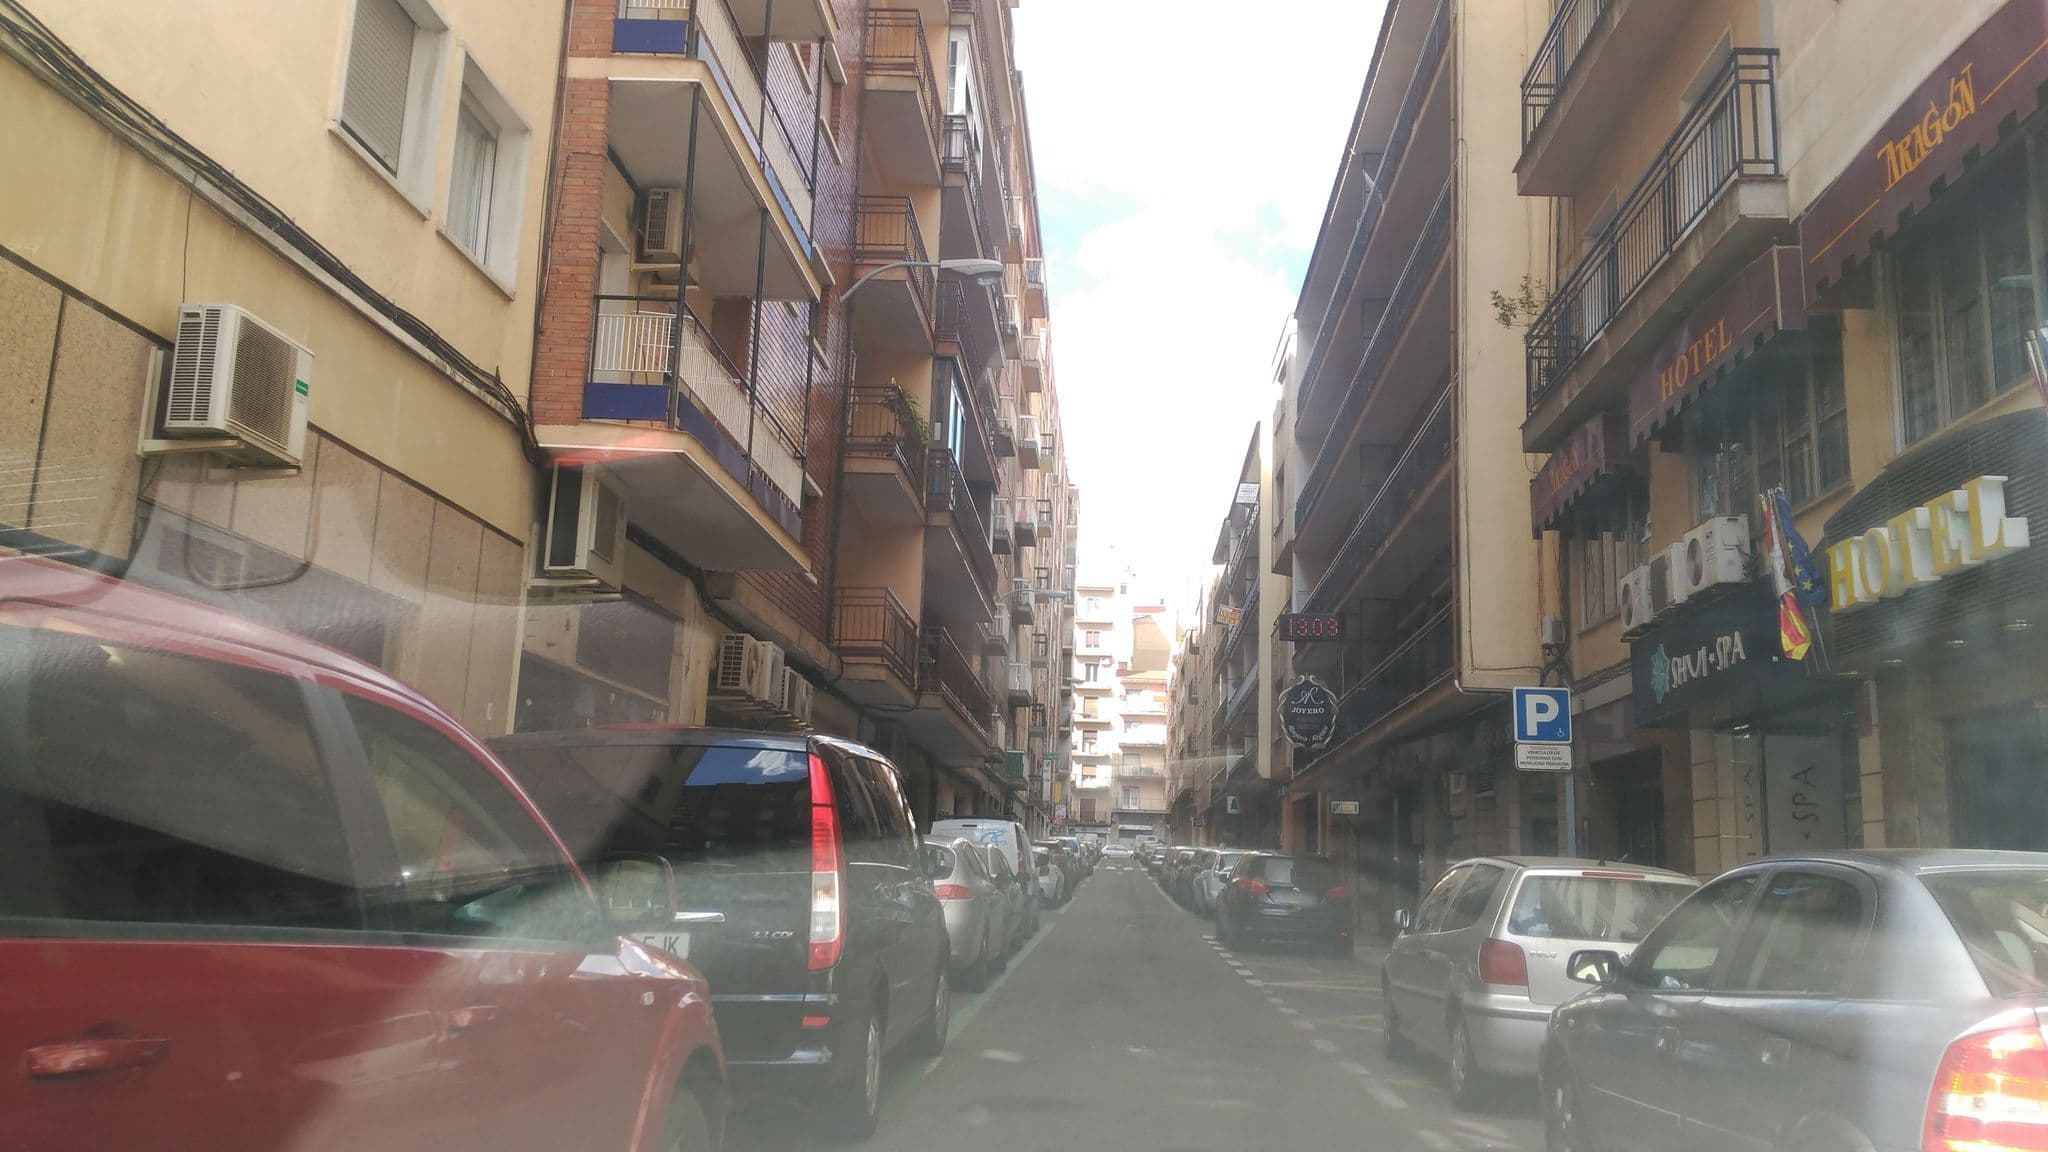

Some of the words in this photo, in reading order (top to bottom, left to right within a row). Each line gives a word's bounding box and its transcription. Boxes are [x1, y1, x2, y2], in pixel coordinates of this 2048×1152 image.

[1877, 62, 1976, 193] ARAGÓN
[1661, 318, 1733, 402] HOTEL
[1827, 475, 2030, 613] HOTEL
[1716, 631, 1746, 671] SPA
[1526, 694, 1559, 736] P
[1792, 764, 1819, 821] SPA
[1530, 950, 1557, 958] POLO
